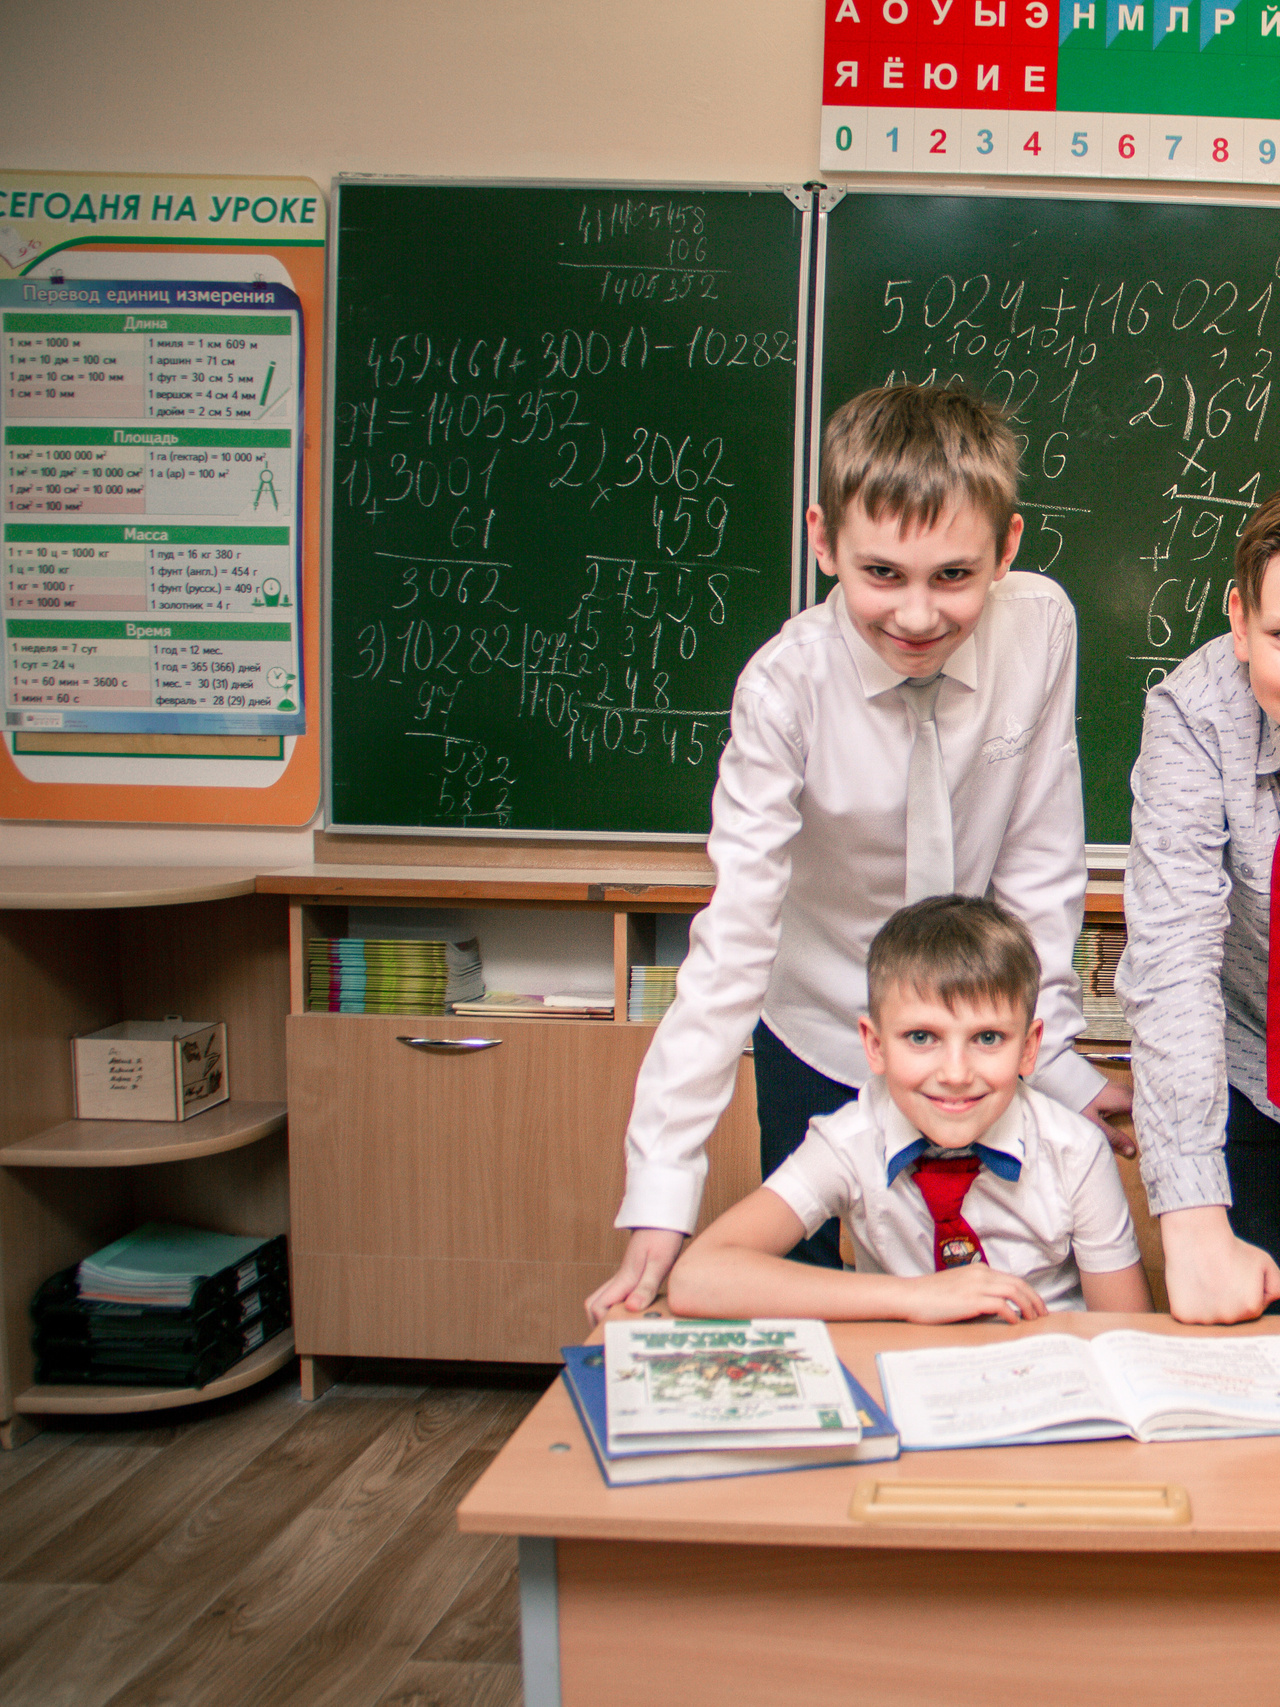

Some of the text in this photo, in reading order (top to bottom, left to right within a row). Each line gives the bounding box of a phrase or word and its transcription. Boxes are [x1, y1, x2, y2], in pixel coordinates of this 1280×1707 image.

[835, 0, 861, 22] А
[882, 0, 908, 24] О
[932, 0, 953, 25] У
[974, 0, 1006, 27] Ы
[1025, 1, 1049, 28] Э
[1073, 3, 1095, 30] Н
[1118, 5, 1145, 31] М
[1165, 6, 1189, 33] Л
[1214, 8, 1236, 35] Р
[834, 61, 859, 87] Я
[883, 57, 904, 89] Ё
[924, 63, 958, 90] Ю
[976, 64, 1000, 91] И
[1024, 66, 1046, 92] Е
[835, 126, 853, 152] 0
[885, 127, 899, 152] 1
[929, 129, 948, 154] 2
[976, 129, 994, 155] 3
[1023, 131, 1042, 156] 4
[1070, 132, 1089, 158] 5
[1117, 134, 1136, 160] 6
[1165, 135, 1183, 161] 7
[1212, 137, 1230, 163] 8
[1258, 139, 1277, 165] 9
[151, 194, 197, 221] НА
[208, 196, 317, 224] УРОКЕ
[667, 236, 707, 265] 106
[23, 284, 275, 305] Перевод единиц измерения
[124, 317, 168, 331] Длина
[46, 337, 69, 347] 1000
[157, 339, 246, 349] миля 609
[83, 354, 100, 364] 100
[156, 358, 192, 367] аршин
[88, 371, 105, 381] 100
[156, 372, 205, 384] фут 30
[156, 391, 193, 401] вершок
[156, 406, 185, 417] дюйм
[113, 430, 179, 445] Площадь
[170, 451, 208, 463] (гектар)
[616, 427, 734, 491] 3062
[166, 469, 215, 479] (ар) 100
[385, 449, 500, 508] 3001
[451, 505, 496, 549] 61
[653, 496, 729, 558] 459
[124, 528, 168, 541] Масса
[72, 548, 95, 558] 1000
[157, 549, 233, 561] пуд 380
[157, 565, 250, 578] фунт (англ.) 454
[42, 581, 66, 591] 1000
[158, 582, 252, 595] фунт (русск.) 409
[393, 566, 520, 613] 3062
[581, 560, 730, 625] 27558
[37, 598, 61, 608] 1000
[158, 602, 204, 610] золотник
[126, 623, 171, 639] Время
[21, 645, 98, 655] неделя сут
[161, 647, 178, 656] год
[190, 645, 199, 655] 12
[396, 620, 522, 674] 10282
[21, 662, 38, 671] сут
[162, 662, 261, 673] год 365 (366) дней
[93, 677, 118, 687] 3600
[198, 679, 209, 688] 30
[212, 679, 228, 690] (31)
[231, 680, 253, 690] дней
[156, 696, 271, 707] февраль 28 (29) дней
